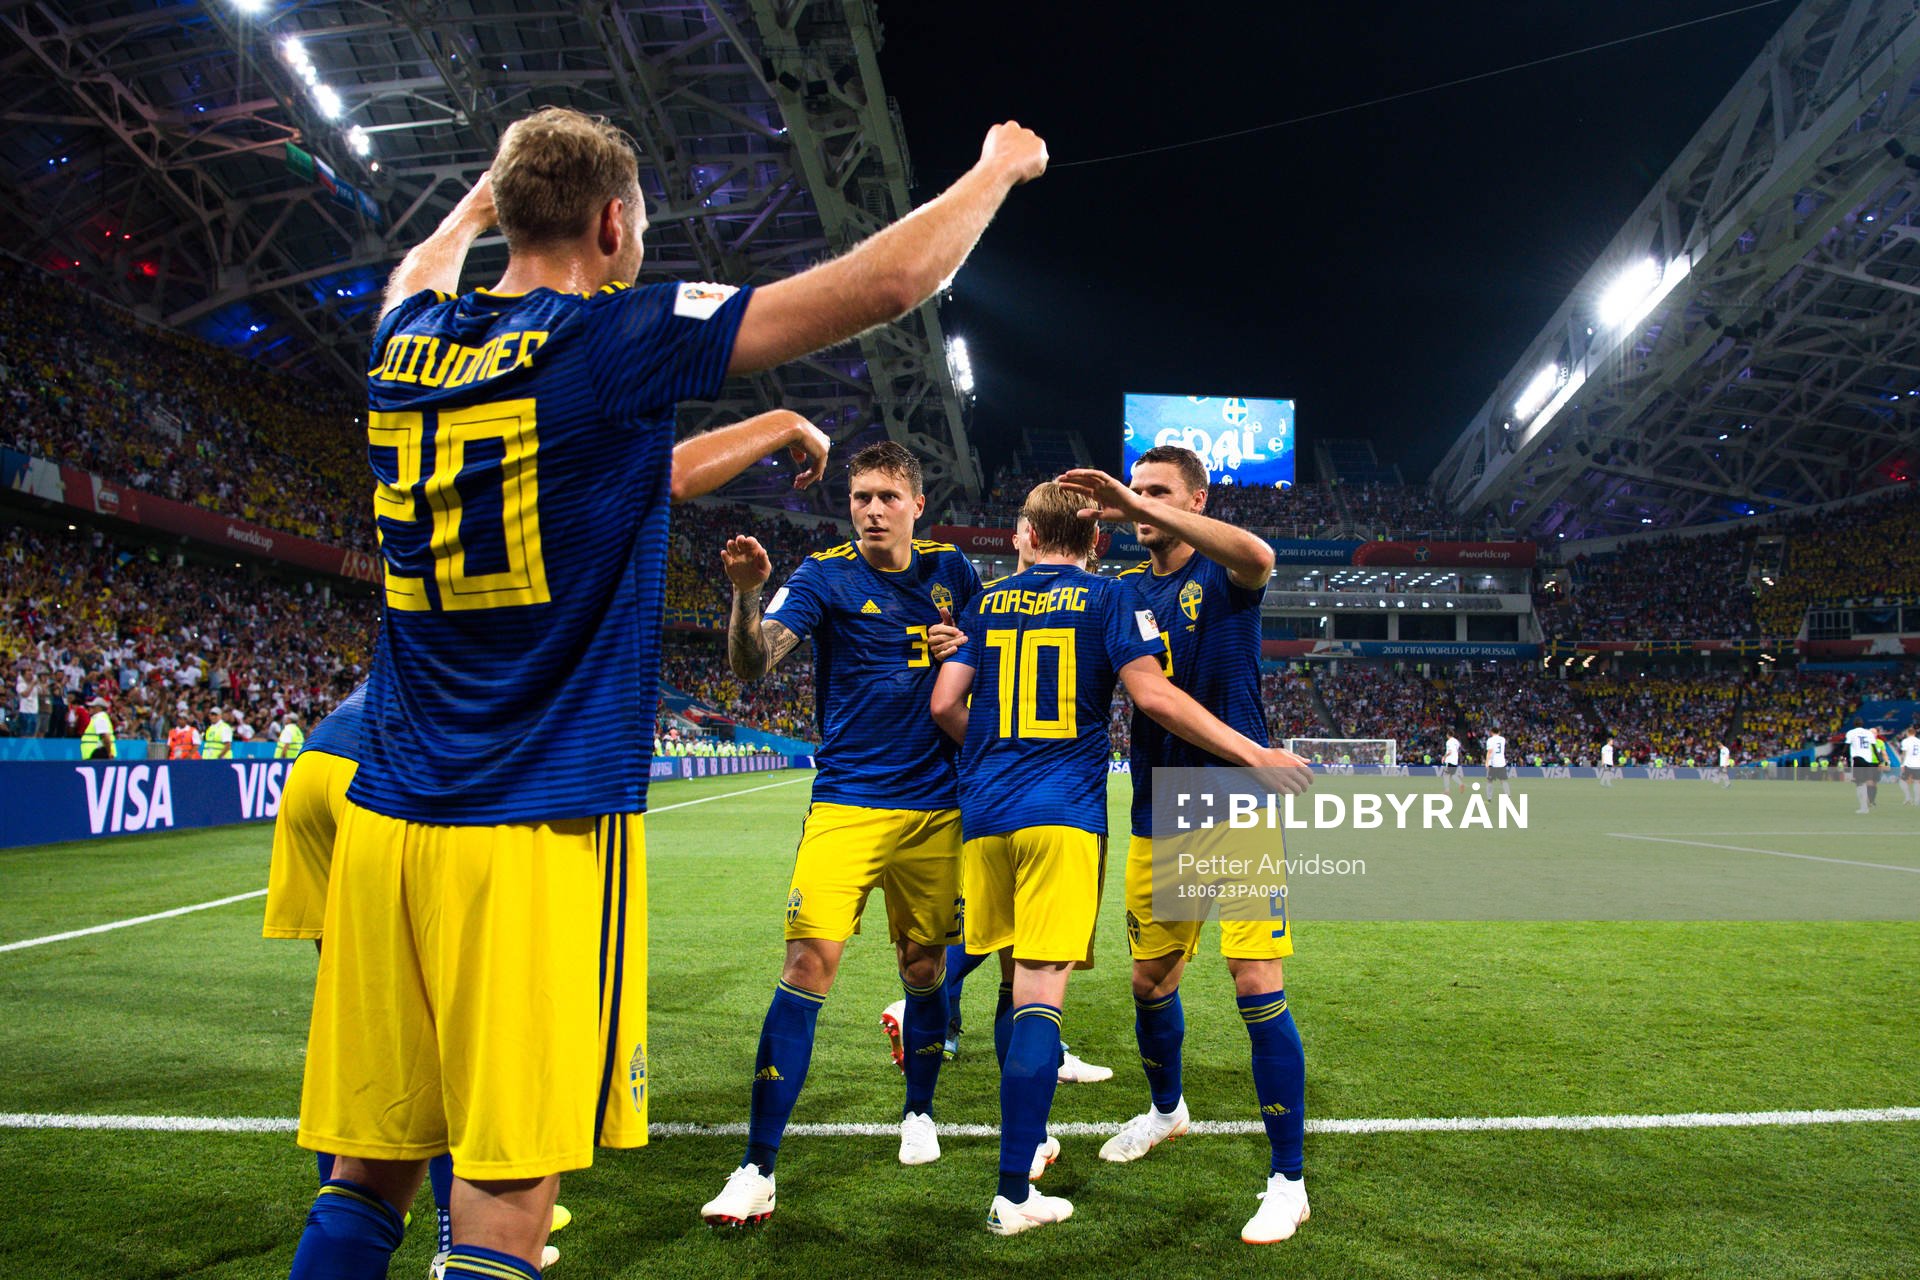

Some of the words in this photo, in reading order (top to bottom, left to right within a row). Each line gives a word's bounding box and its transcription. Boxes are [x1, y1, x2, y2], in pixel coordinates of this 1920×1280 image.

[1154, 427, 1265, 460] GOAL
[368, 398, 551, 611] 20
[227, 525, 273, 552] #worldcup
[972, 536, 1004, 547] СОЧИ
[1459, 550, 1511, 560] #worldcup
[979, 587, 1089, 615] FORSBERG
[906, 625, 930, 668] 3
[1404, 646, 1424, 655] FIFA
[1426, 646, 1459, 655] WORLD
[1460, 646, 1480, 655] CUP
[1482, 647, 1516, 656] RUSSIA
[986, 628, 1078, 739] 10
[1108, 761, 1131, 773] ISA
[1322, 764, 1354, 775] VISA
[1540, 767, 1571, 779] VISA
[1645, 768, 1676, 780] VISA
[75, 765, 173, 834] VISA
[1270, 889, 1286, 938] 9
